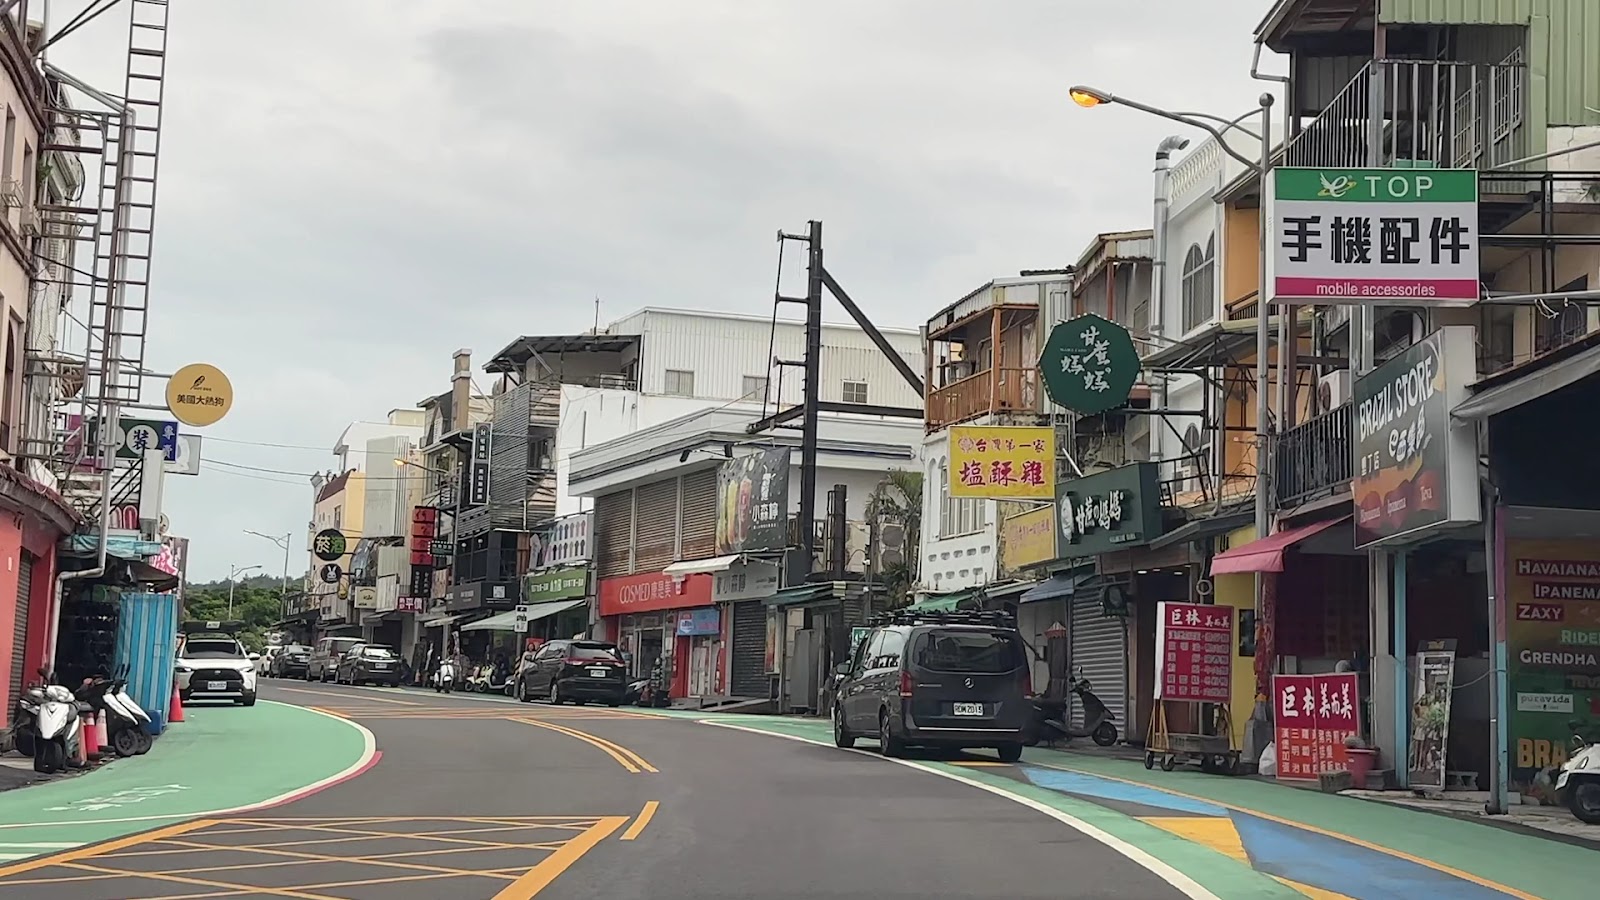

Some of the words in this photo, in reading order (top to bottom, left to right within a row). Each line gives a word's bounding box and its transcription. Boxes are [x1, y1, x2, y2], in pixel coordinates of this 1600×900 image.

[1364, 176, 1433, 198] TOP
[1282, 215, 1470, 265] 手機配件
[1316, 282, 1358, 296] mobile
[1362, 283, 1436, 296] accessories
[176, 394, 225, 407] 美國大熱狗
[1360, 383, 1393, 443] BRAZIL
[1395, 355, 1434, 418] STORE
[959, 459, 1046, 487] 塩酥雞
[316, 536, 344, 554] 菸酒
[1519, 560, 1600, 576] HAVAIANA
[620, 582, 651, 604] COSMED
[1171, 608, 1201, 626] 巨林
[1518, 604, 1562, 620] ZAXY
[1561, 629, 1600, 645] RIDE
[1519, 649, 1597, 666] GRENDHA
[1320, 682, 1353, 719] 美而美
